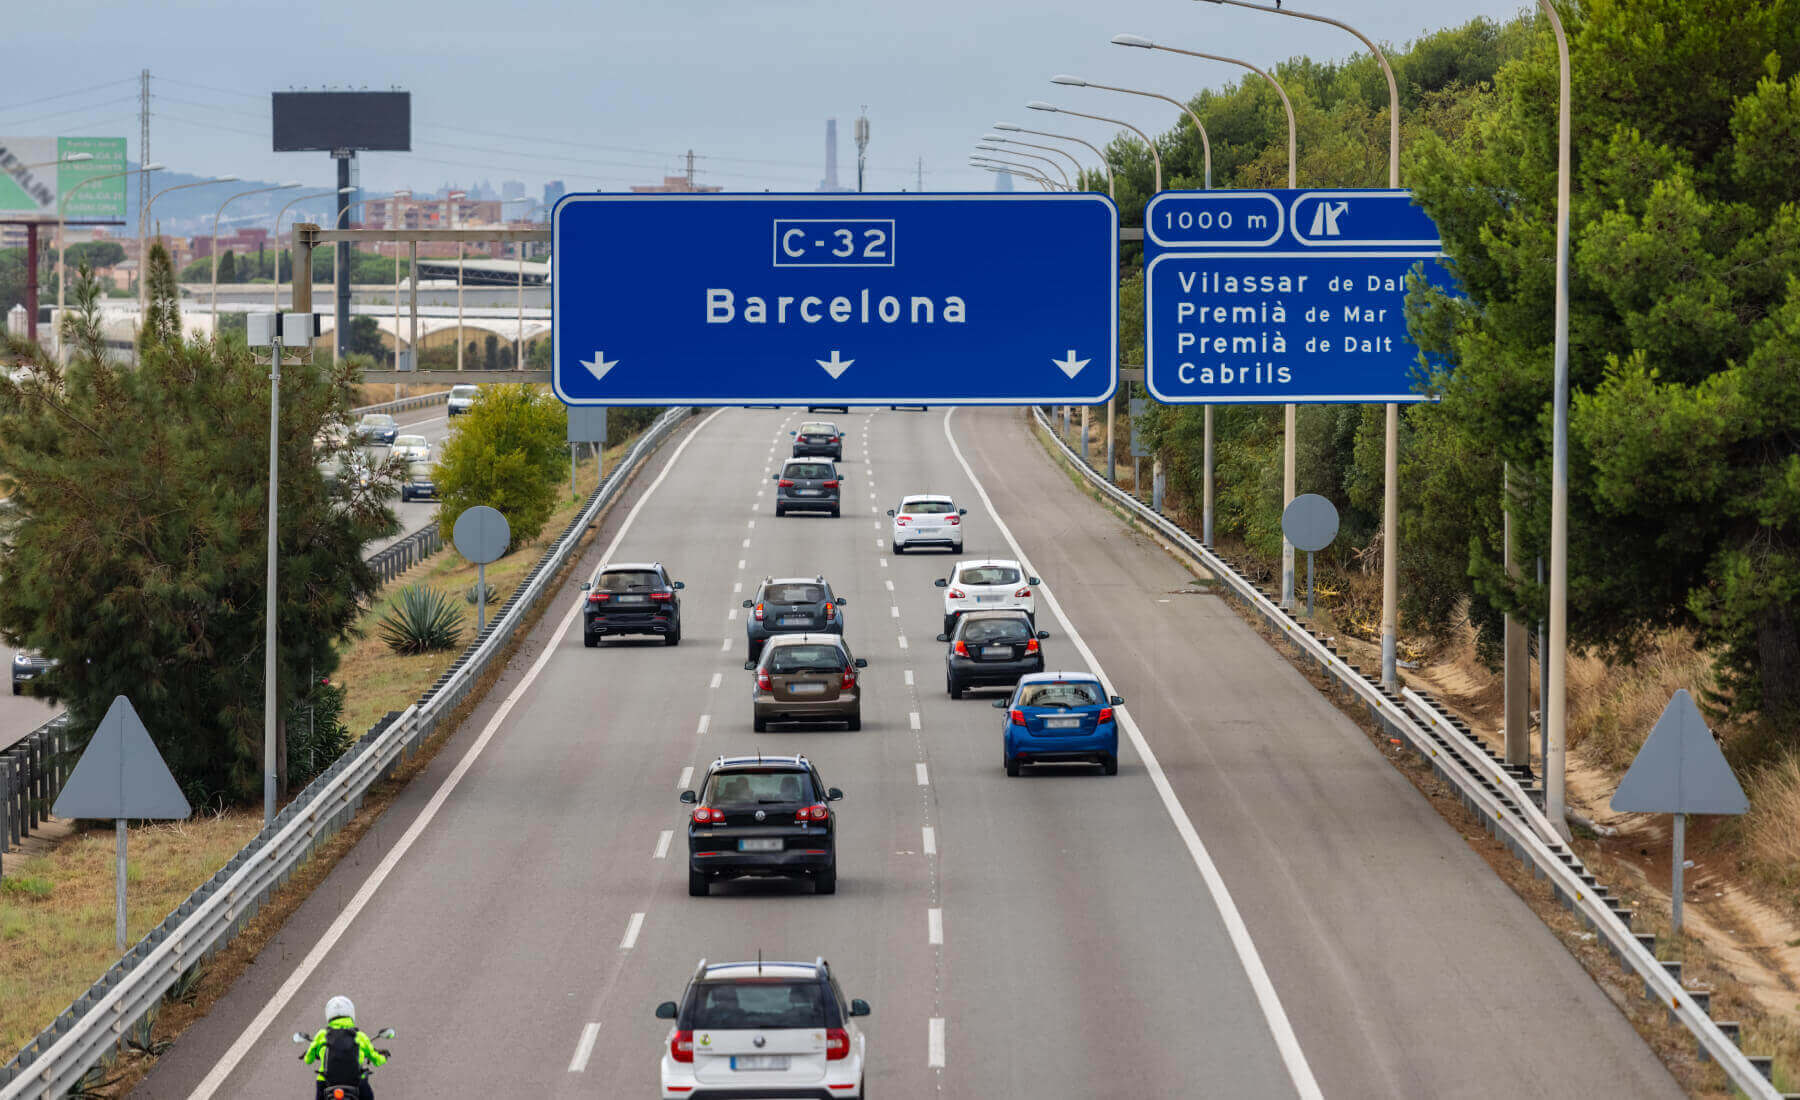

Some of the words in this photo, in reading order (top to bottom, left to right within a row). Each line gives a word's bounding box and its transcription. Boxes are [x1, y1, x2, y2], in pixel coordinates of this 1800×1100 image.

[1166, 211, 1233, 229] 1000
[1247, 215, 1267, 229] m
[782, 229, 886, 258] C-32
[1178, 271, 1308, 293] Vilassar
[1328, 276, 1354, 292] de
[1367, 276, 1406, 292] Dal
[706, 288, 966, 323] Barcelona
[1178, 301, 1286, 324] Premià
[1305, 306, 1330, 323] de
[1344, 306, 1387, 323] Mar
[1178, 331, 1286, 354] Premià
[1305, 336, 1330, 353] de
[1344, 336, 1392, 353] Dalt
[1178, 362, 1292, 384] Cabrils
